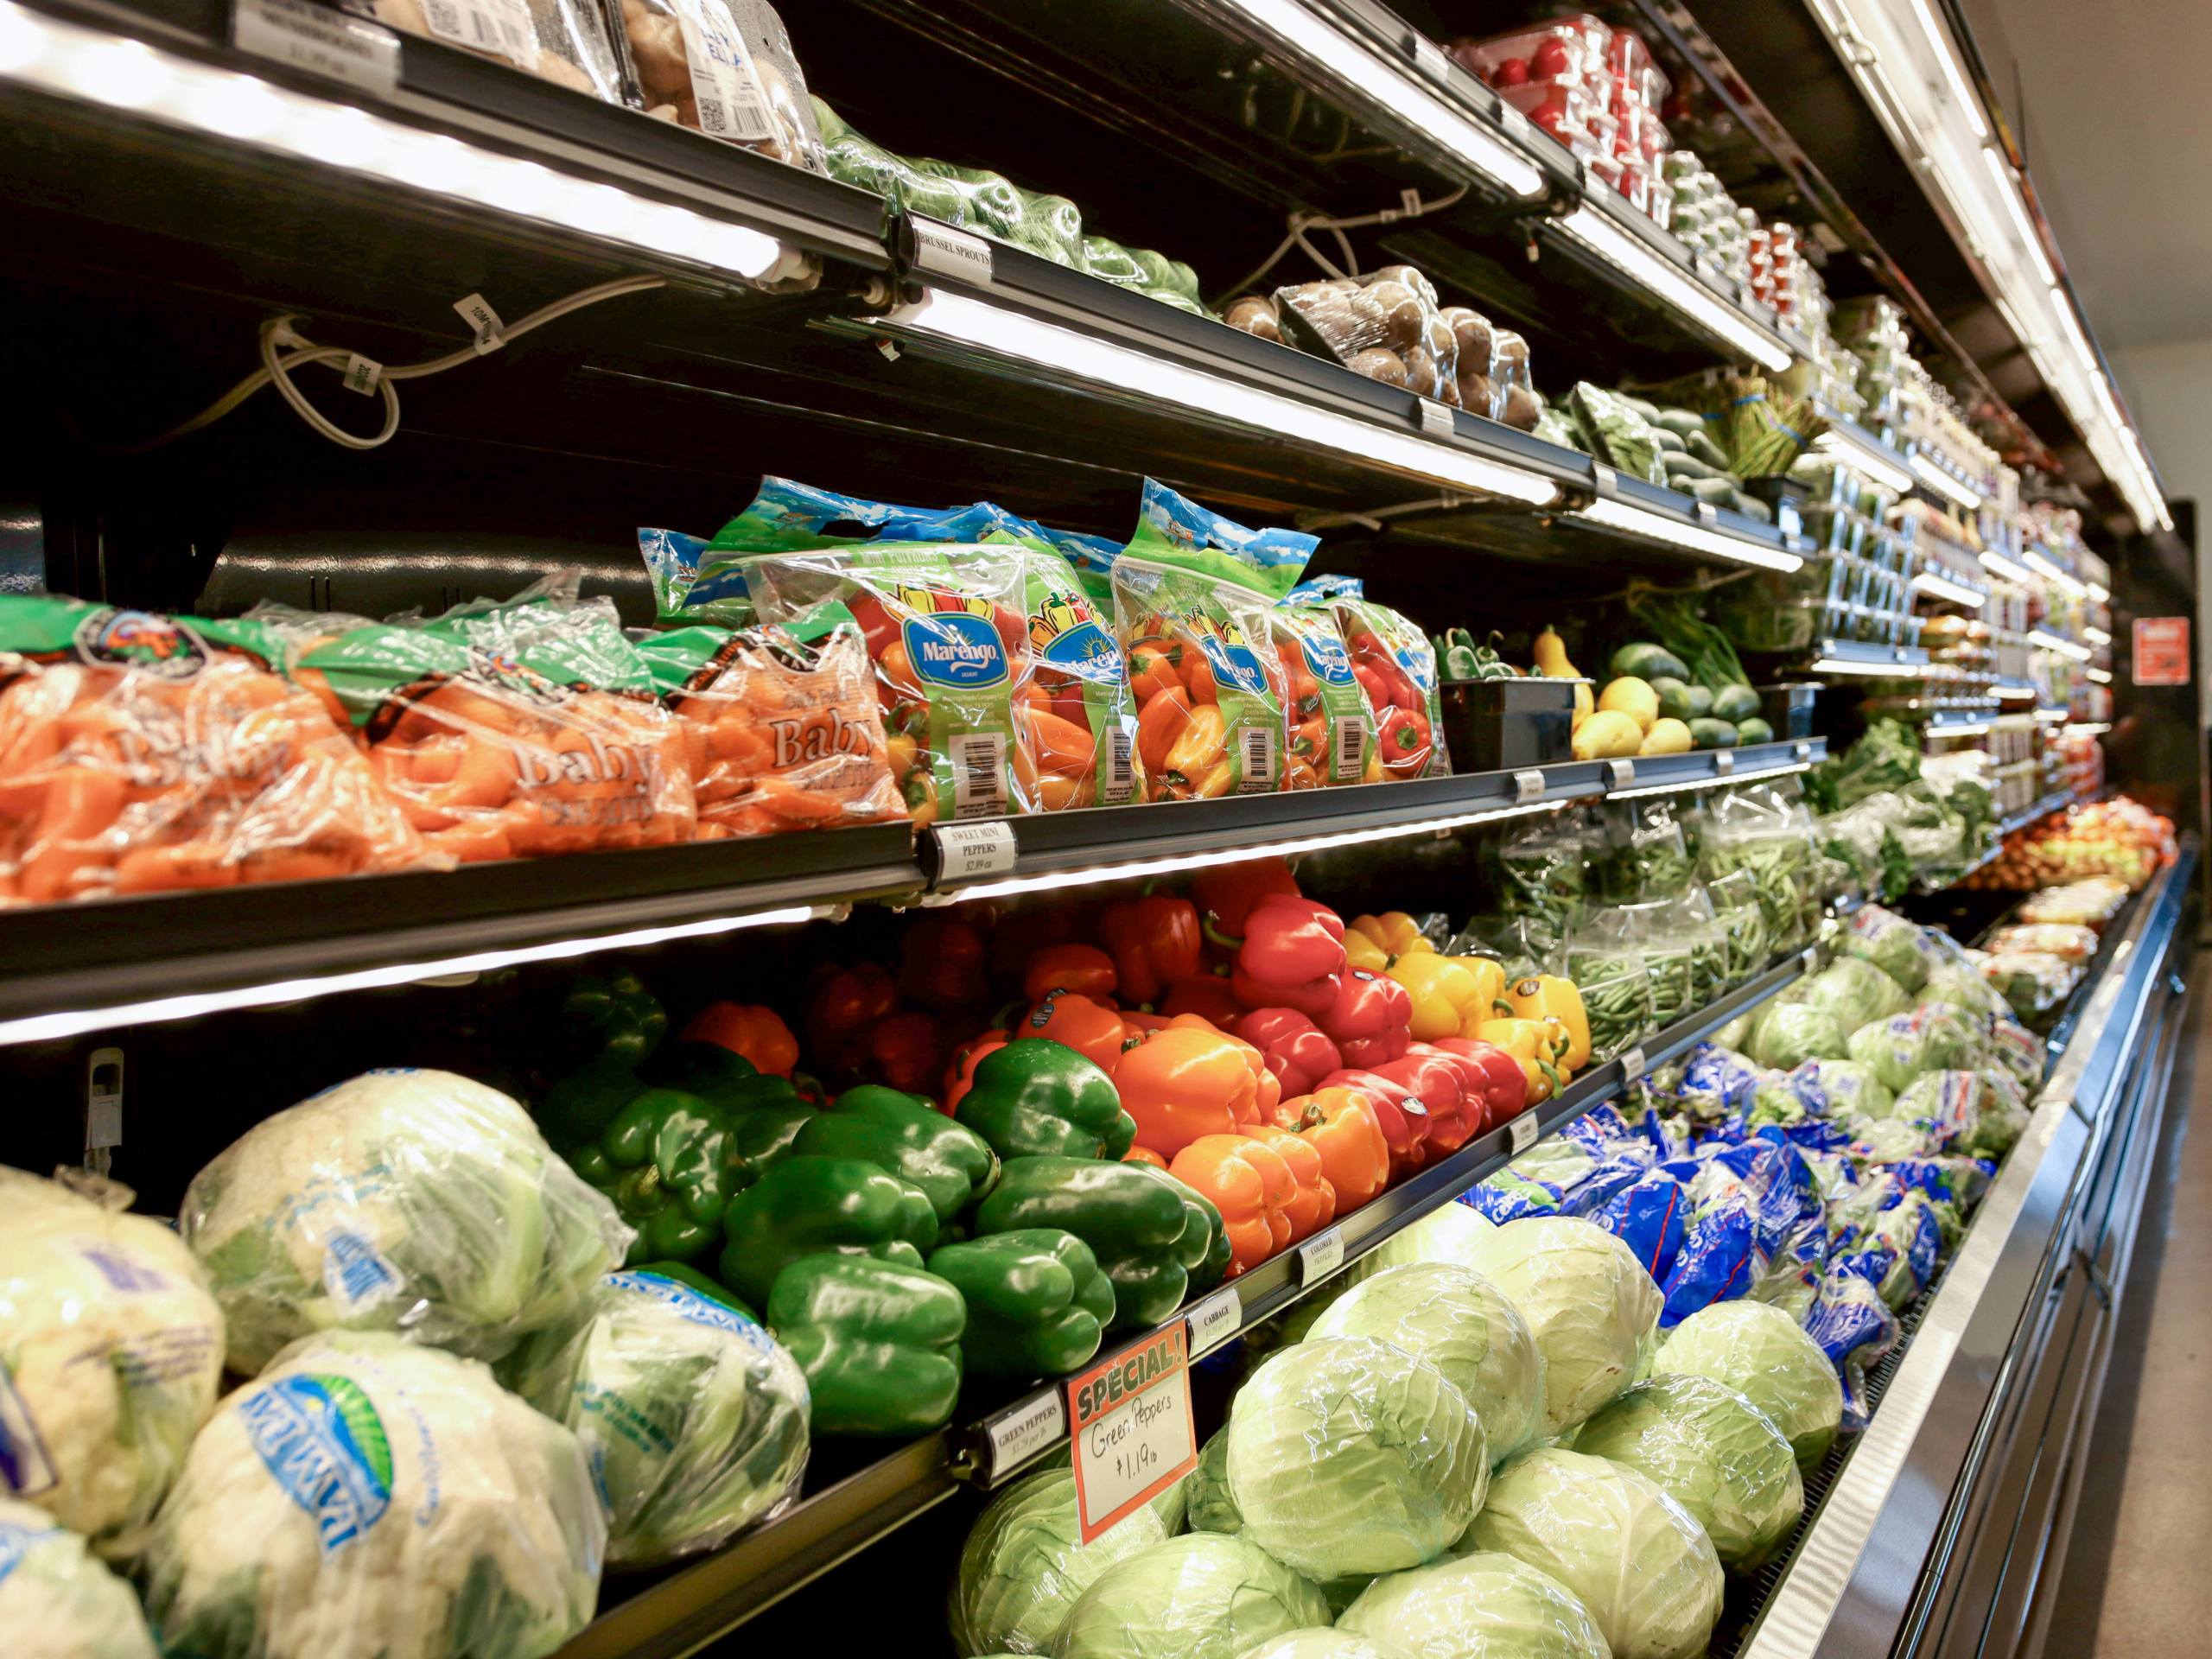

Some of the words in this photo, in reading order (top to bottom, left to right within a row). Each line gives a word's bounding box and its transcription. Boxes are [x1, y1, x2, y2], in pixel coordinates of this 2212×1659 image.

[919, 232, 955, 254] BRUSSEL
[955, 245, 990, 265] SPROUTS
[922, 641, 997, 673] Marengo
[768, 707, 874, 769] Baby
[512, 730, 652, 795] Baby
[951, 830, 979, 842] SWEET
[980, 826, 1000, 838] MINI
[963, 843, 997, 856] PEPPERS
[965, 860, 984, 872] $2.89
[1310, 1236, 1333, 1255] COLORED
[1313, 1249, 1334, 1267] PEPPERS
[1204, 1305, 1230, 1326] CABBAGE
[1077, 1331, 1184, 1424] SPECIAL!
[998, 1424, 1026, 1447] GREEN
[1025, 1403, 1057, 1432] PEPPERS
[1090, 1418, 1130, 1459] Green
[1131, 1395, 1172, 1428] Peppers
[1116, 1442, 1149, 1479] $1.19
